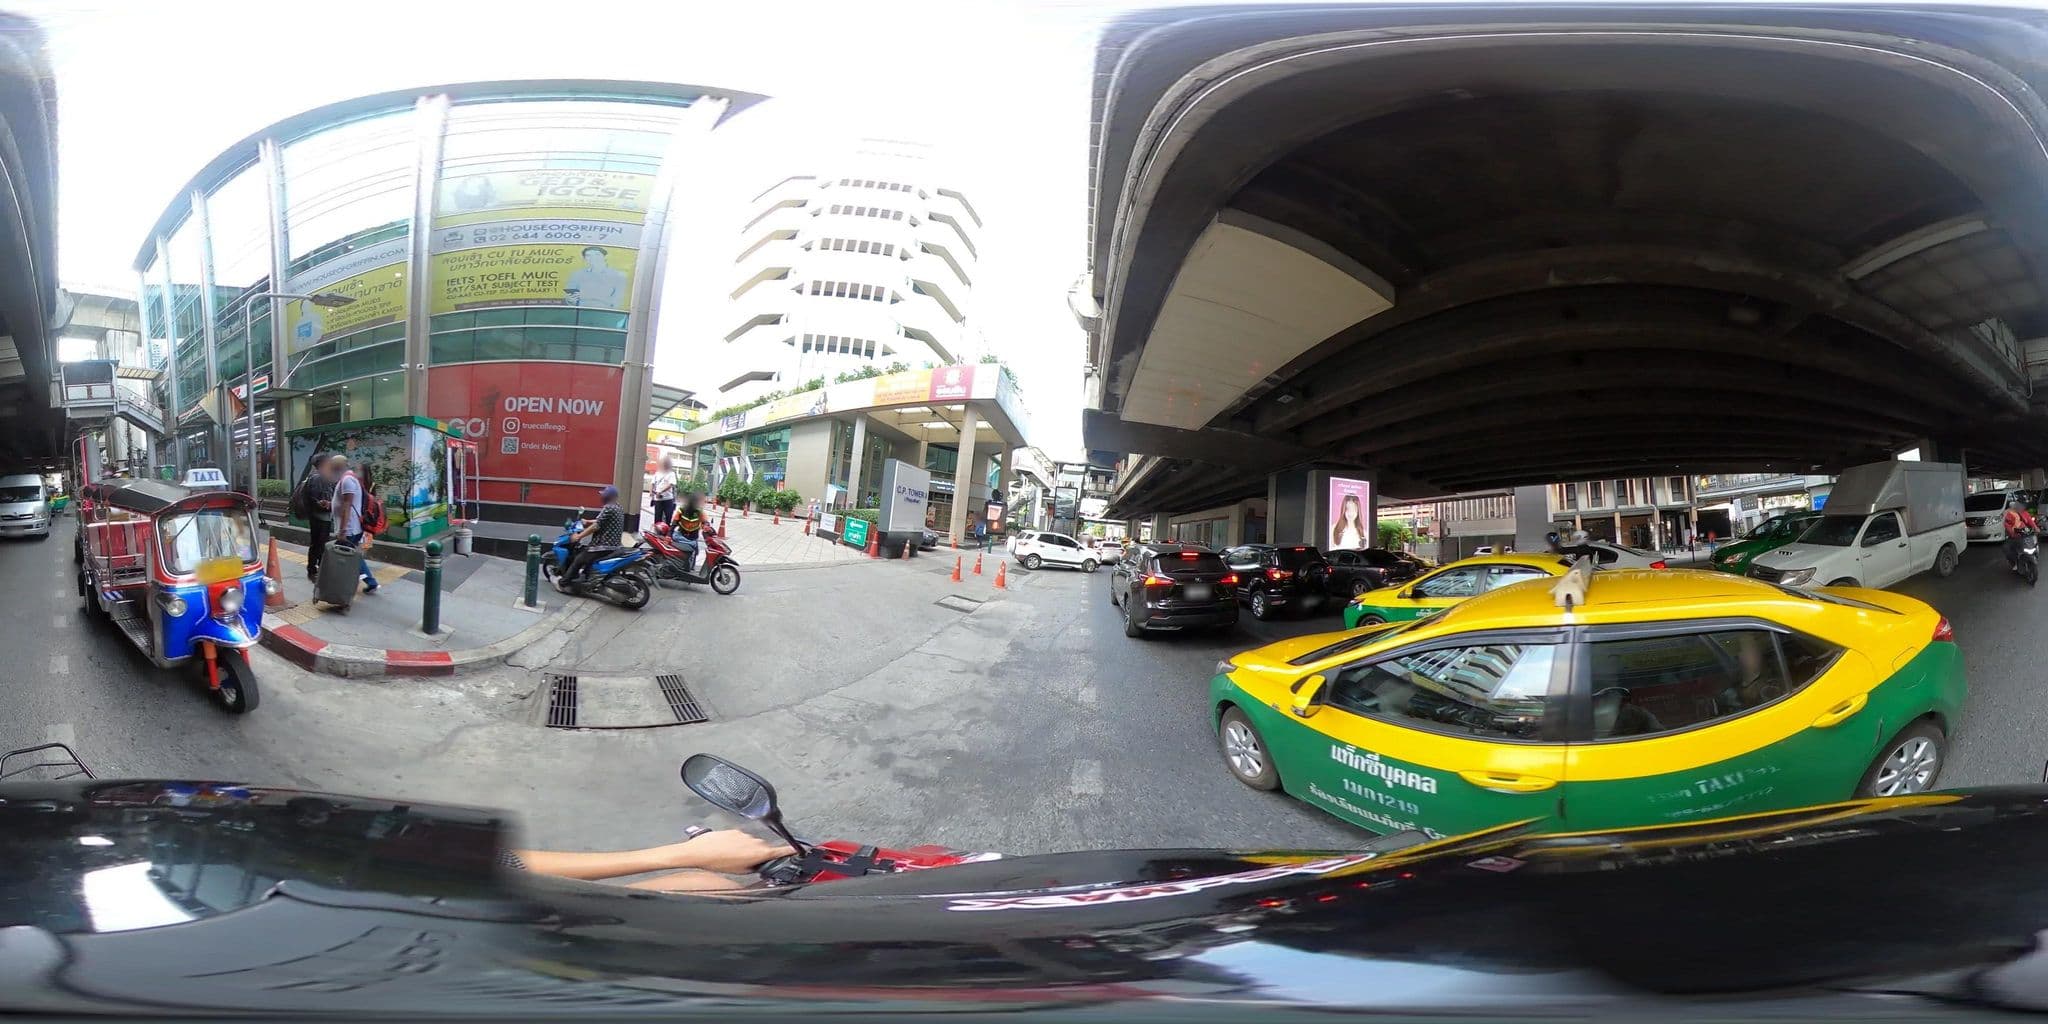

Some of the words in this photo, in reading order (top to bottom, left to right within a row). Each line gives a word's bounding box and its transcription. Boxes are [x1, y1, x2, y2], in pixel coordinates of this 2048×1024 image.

[520, 176, 585, 186] GED
[538, 185, 641, 200] IGCSE
[489, 234, 507, 242] 02
[512, 232, 538, 240] 644
[544, 231, 582, 239] 6006
[511, 249, 525, 257] TU
[529, 248, 565, 257] MUIC
[446, 275, 475, 287] IELTS
[480, 273, 517, 282] TOEFL
[521, 271, 558, 280] MUIC
[446, 282, 488, 295] SAT/SAT
[492, 280, 531, 290] SUBJECT
[537, 280, 559, 288] TEST
[504, 396, 553, 413] OPEN
[557, 397, 604, 417] NOW
[521, 442, 541, 451] Order
[542, 443, 561, 452] Now!
[192, 470, 220, 482] TAXI
[908, 487, 925, 498] TOWER
